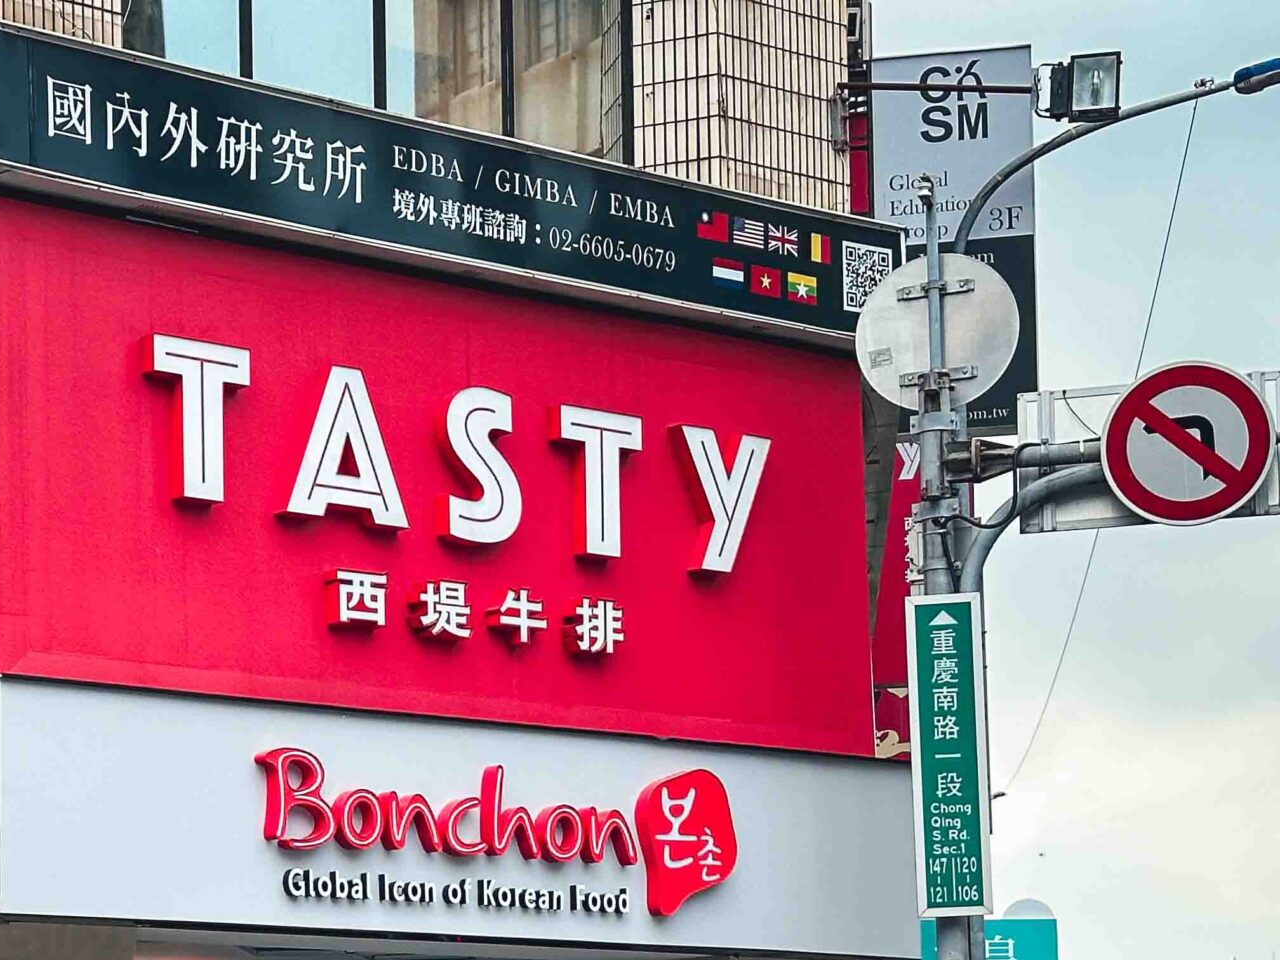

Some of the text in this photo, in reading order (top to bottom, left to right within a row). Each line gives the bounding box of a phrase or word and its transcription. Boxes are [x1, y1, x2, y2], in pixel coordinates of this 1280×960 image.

[46, 75, 367, 204] 國內外研究所
[920, 102, 989, 143] SM
[392, 145, 464, 182] EDBA
[495, 168, 578, 207] GIMBA
[609, 194, 676, 228] EMBA
[889, 170, 948, 191] Gloal
[988, 205, 1023, 231] 3F
[549, 226, 677, 273] 02-6605-0679
[140, 332, 772, 577] TASTY
[327, 568, 626, 654] 西堤牛排
[930, 629, 963, 798] 重慶南路一段
[255, 747, 637, 866] Bonchon
[930, 803, 972, 815] Chong
[931, 817, 961, 829] Qing
[932, 830, 970, 841] S. Rd.
[929, 857, 977, 874] 147 120
[283, 867, 631, 914] Global Icon of Korean Food
[930, 885, 979, 903] 121 106
